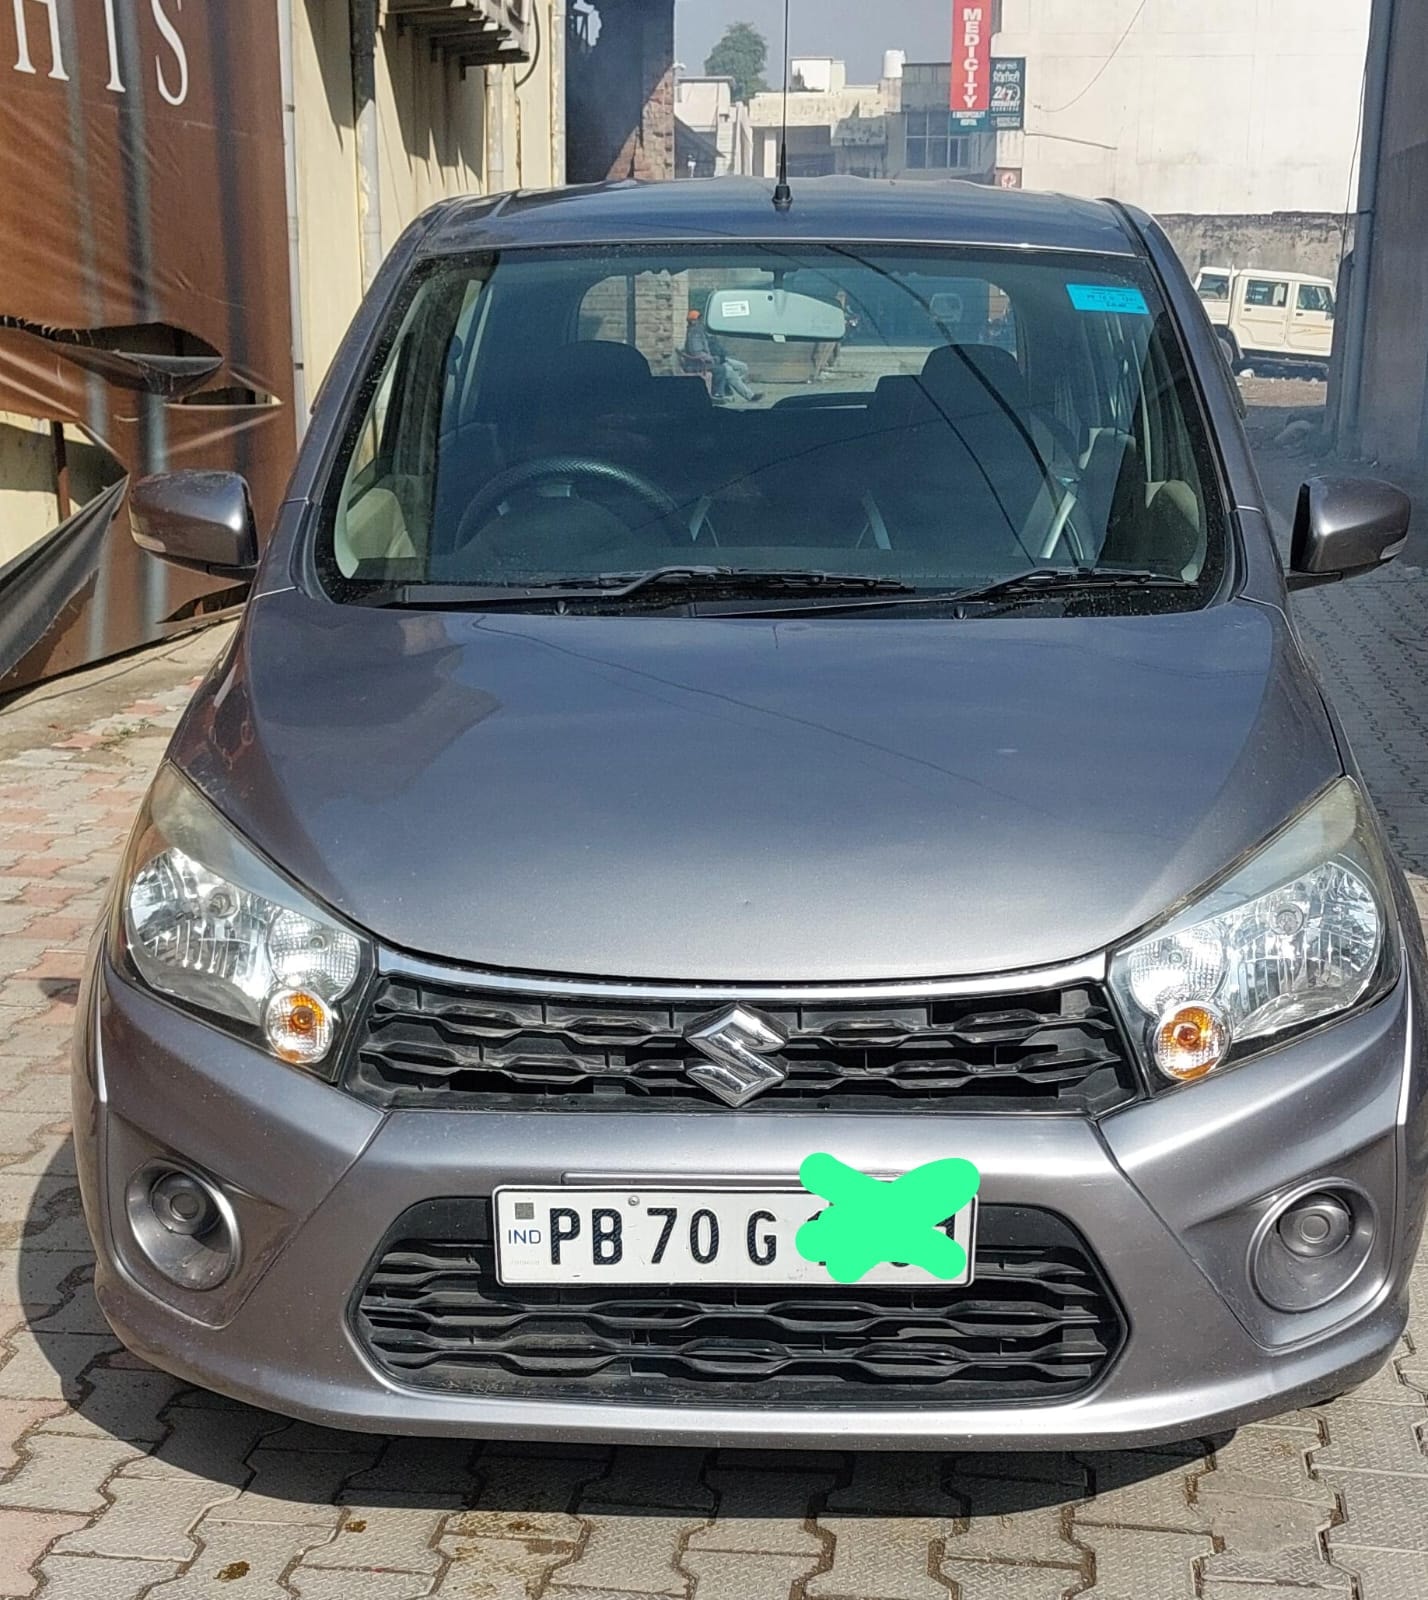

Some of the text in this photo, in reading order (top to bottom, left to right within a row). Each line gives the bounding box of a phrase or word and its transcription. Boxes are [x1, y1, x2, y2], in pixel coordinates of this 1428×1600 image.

[963, 8, 982, 108] MEDICITY
[508, 1229, 541, 1244] IND
[550, 1208, 623, 1265] PB
[647, 1208, 719, 1264] 70
[747, 1210, 777, 1266] G
